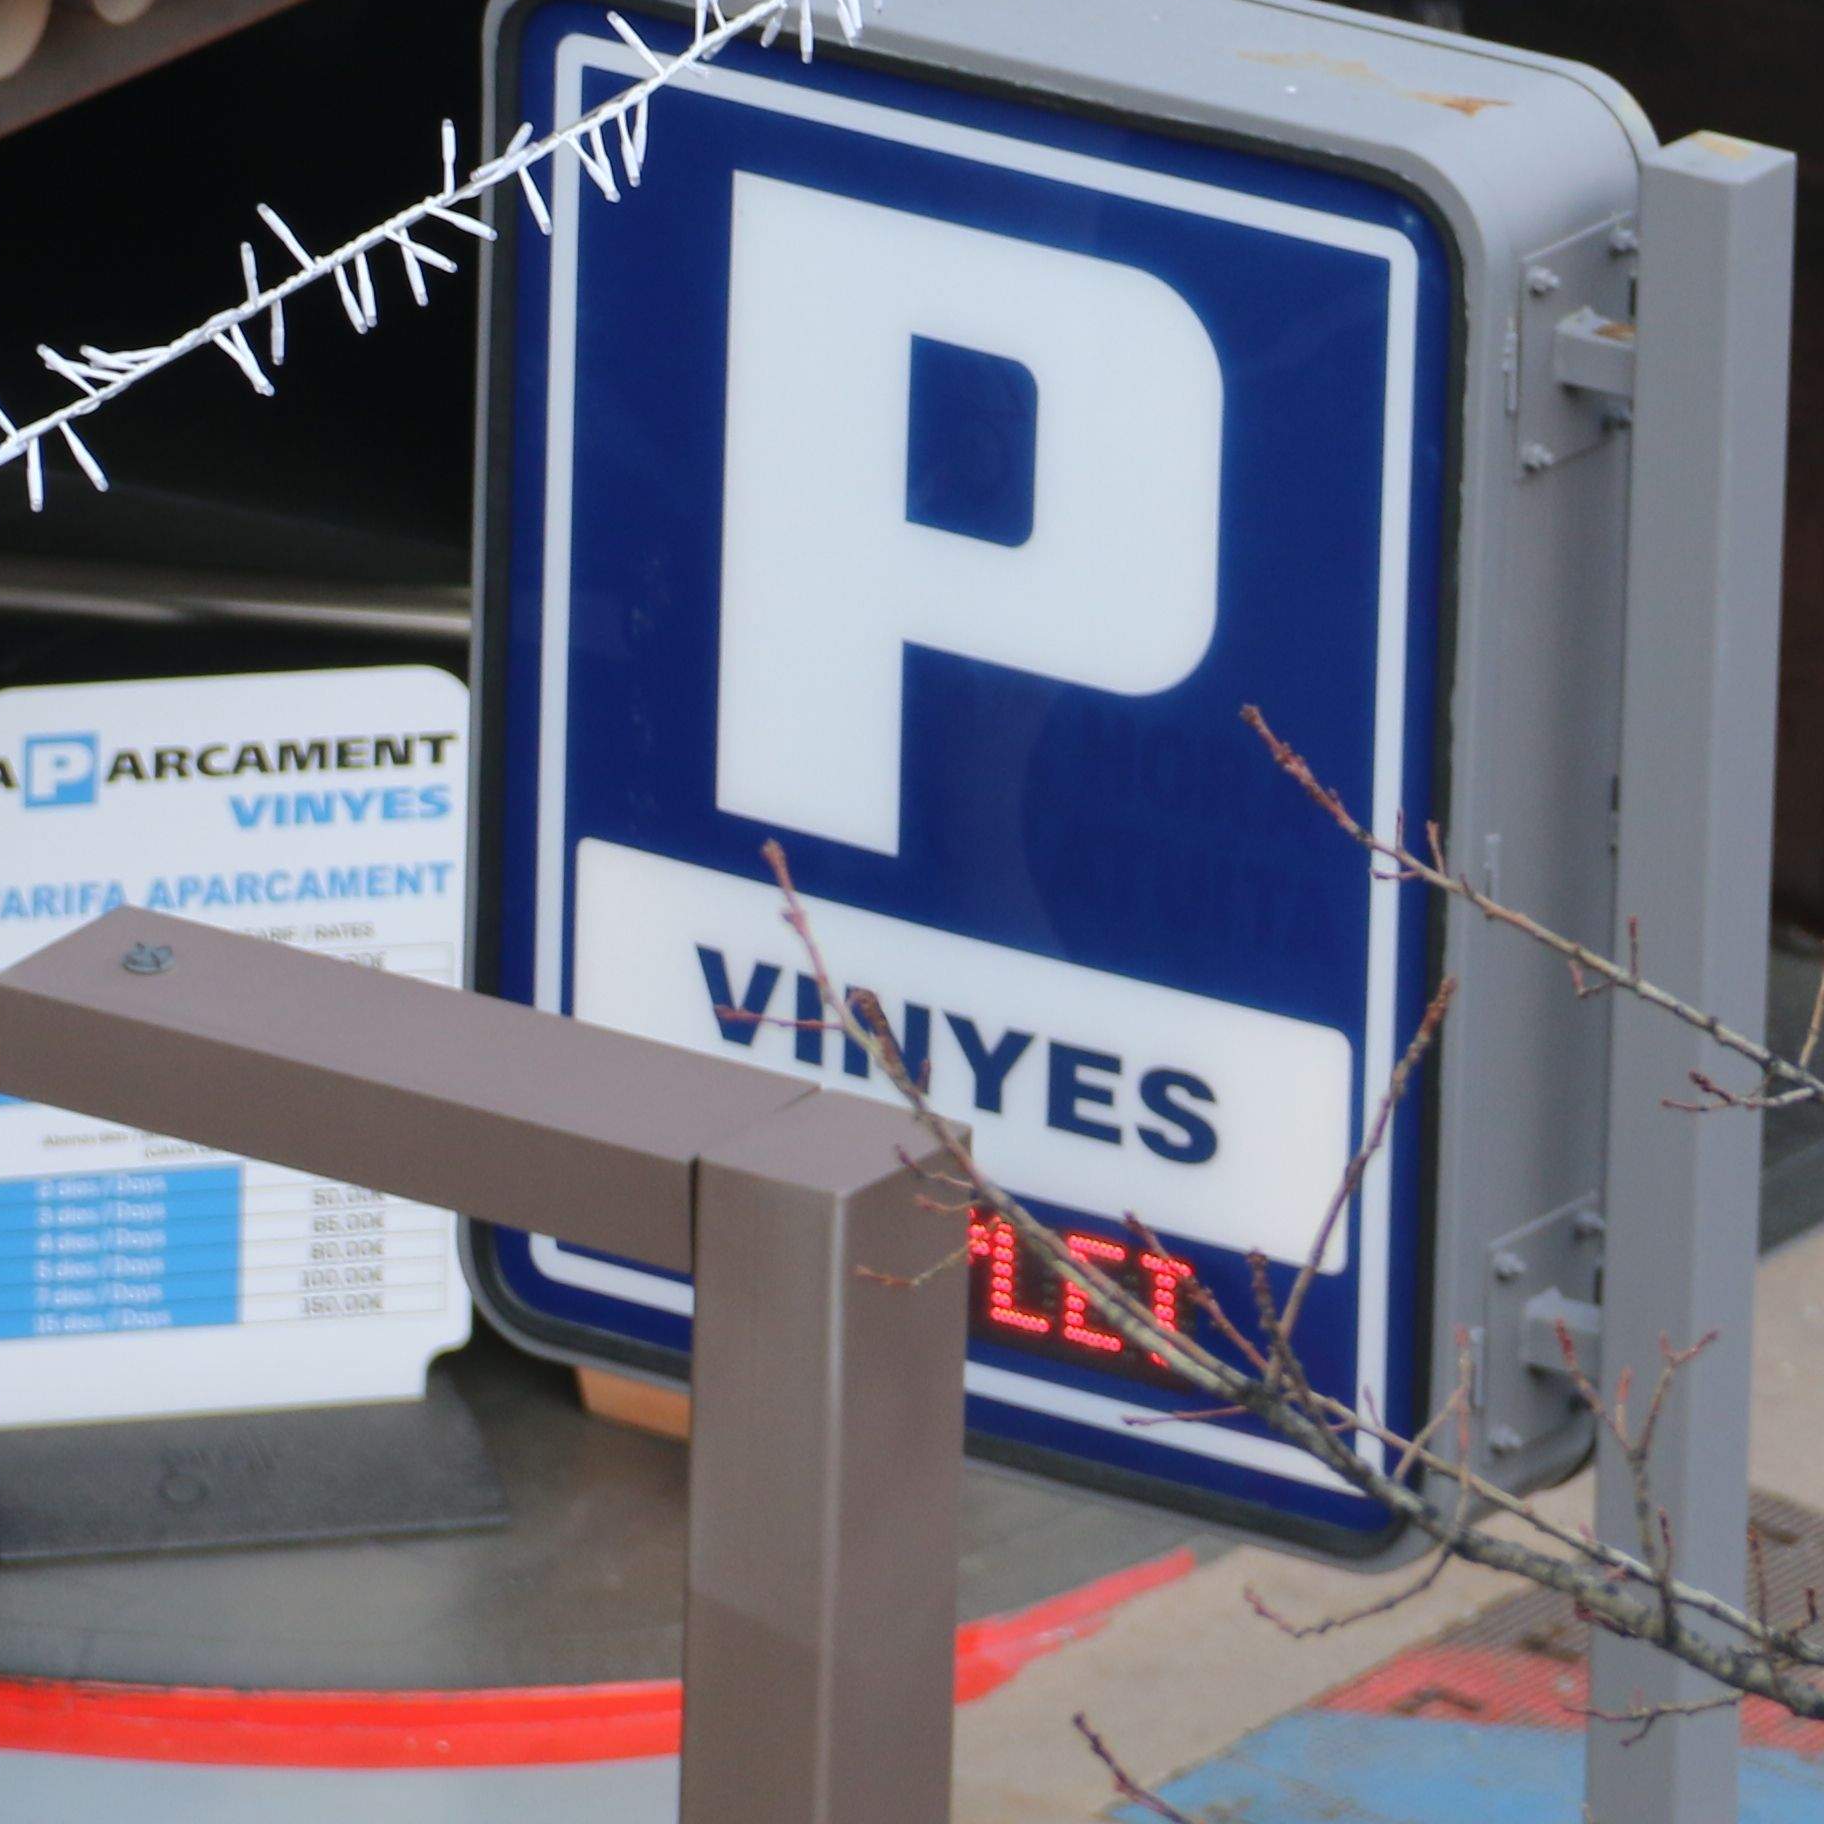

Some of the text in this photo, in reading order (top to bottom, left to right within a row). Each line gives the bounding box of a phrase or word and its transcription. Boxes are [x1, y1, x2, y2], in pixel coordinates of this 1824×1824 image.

[716, 170, 1224, 856] P
[229, 784, 451, 832] VINYES
[146, 860, 454, 912] APARCAMENT
[696, 945, 1218, 1166] VINYES
